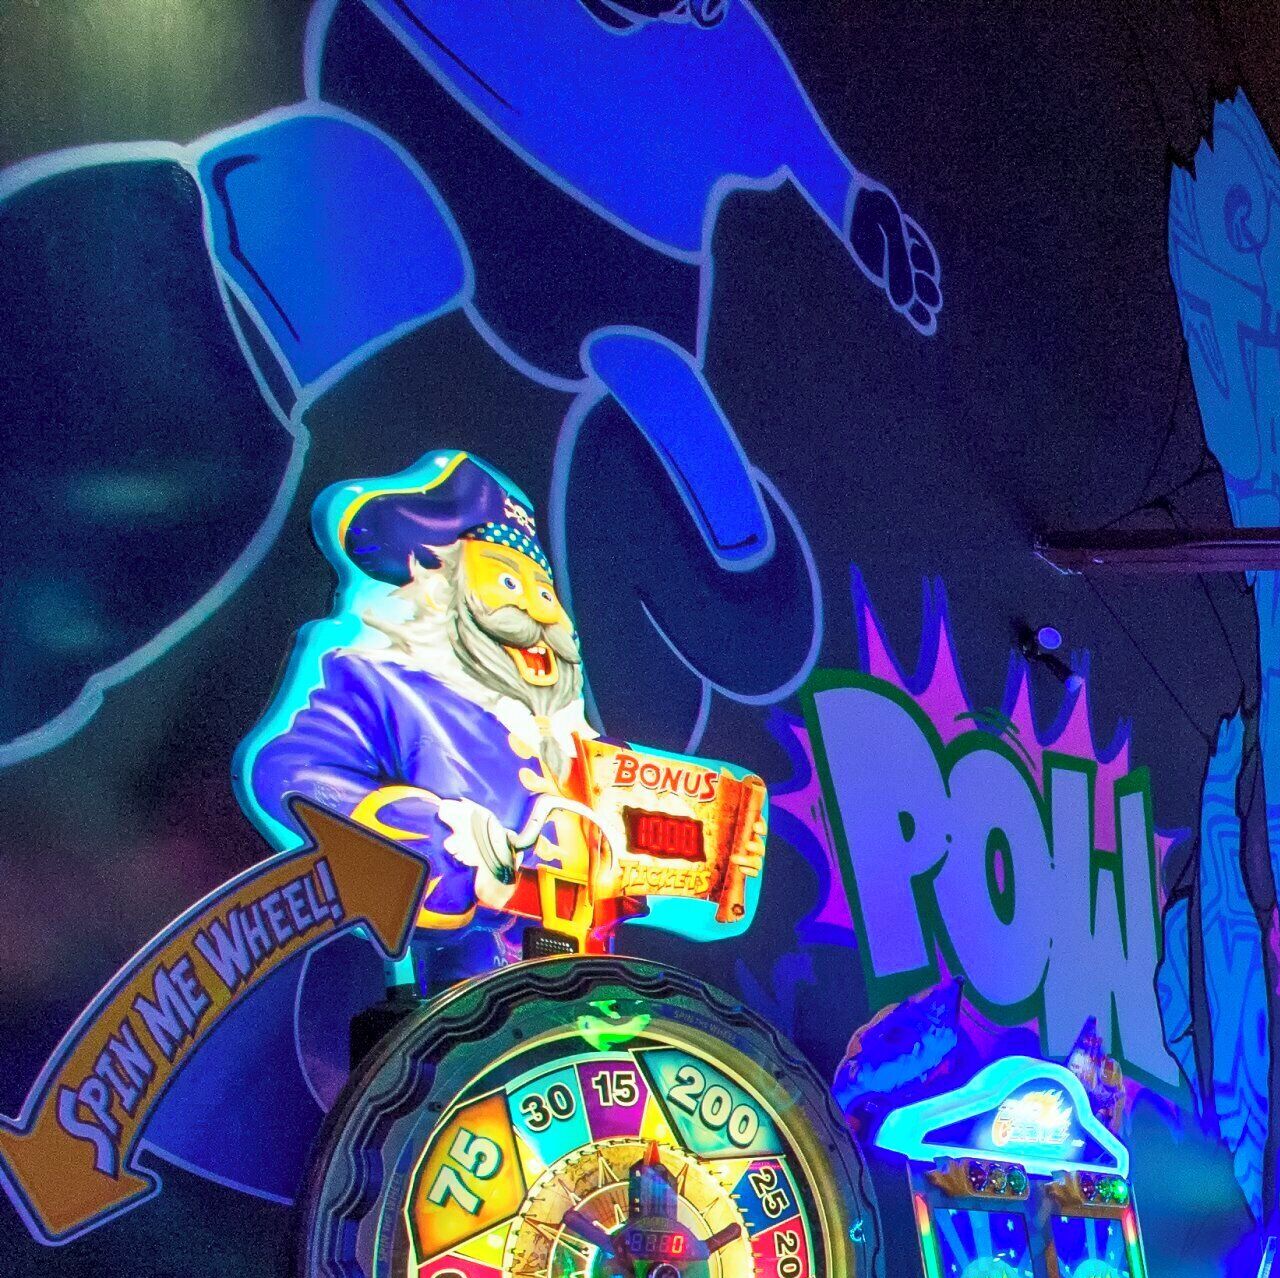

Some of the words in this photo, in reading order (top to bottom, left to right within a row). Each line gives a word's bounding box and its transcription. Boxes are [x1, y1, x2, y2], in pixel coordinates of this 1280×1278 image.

[612, 754, 719, 803] BONUS
[637, 816, 699, 857] 1000
[618, 859, 713, 894] TICKETS
[809, 678, 1183, 1090] POW
[55, 1037, 155, 1178] SPIN
[136, 957, 210, 1060] ME
[199, 859, 344, 985] WHEEL!
[520, 1082, 576, 1133] 30
[591, 1071, 640, 1106] 15
[667, 1064, 760, 1148] 200
[428, 1131, 504, 1215] 75
[746, 1166, 790, 1219] 25
